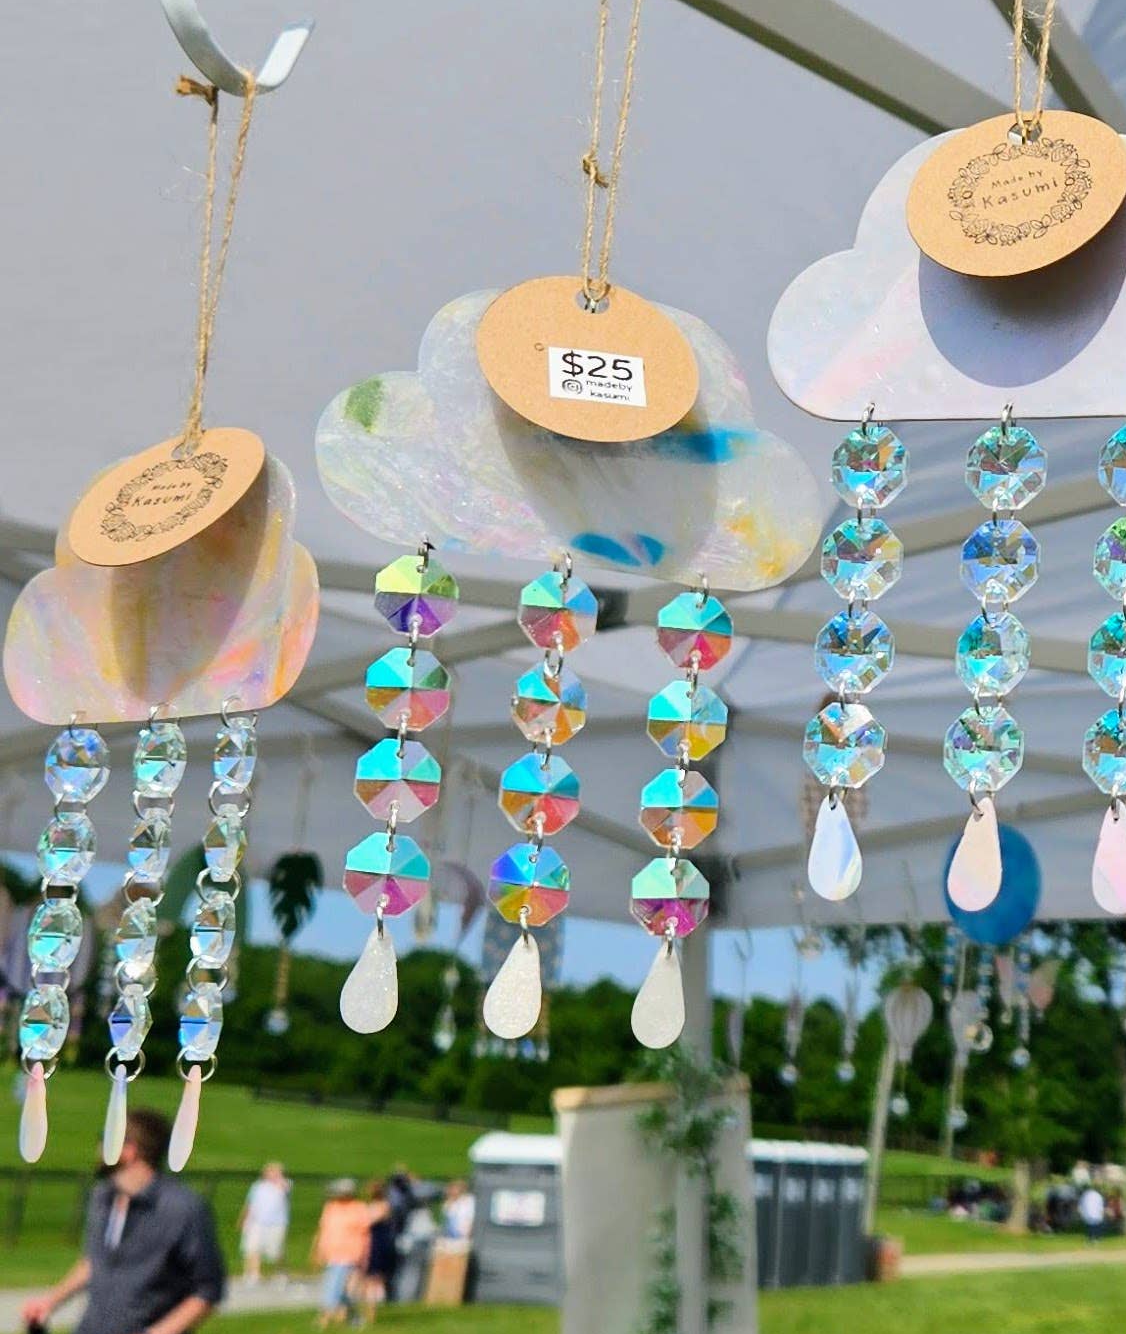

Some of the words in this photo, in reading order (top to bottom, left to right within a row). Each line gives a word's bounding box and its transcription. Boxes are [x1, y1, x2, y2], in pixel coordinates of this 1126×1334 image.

[982, 176, 1058, 209] Kasumi
[562, 350, 633, 381] $25
[586, 380, 632, 392] madeby
